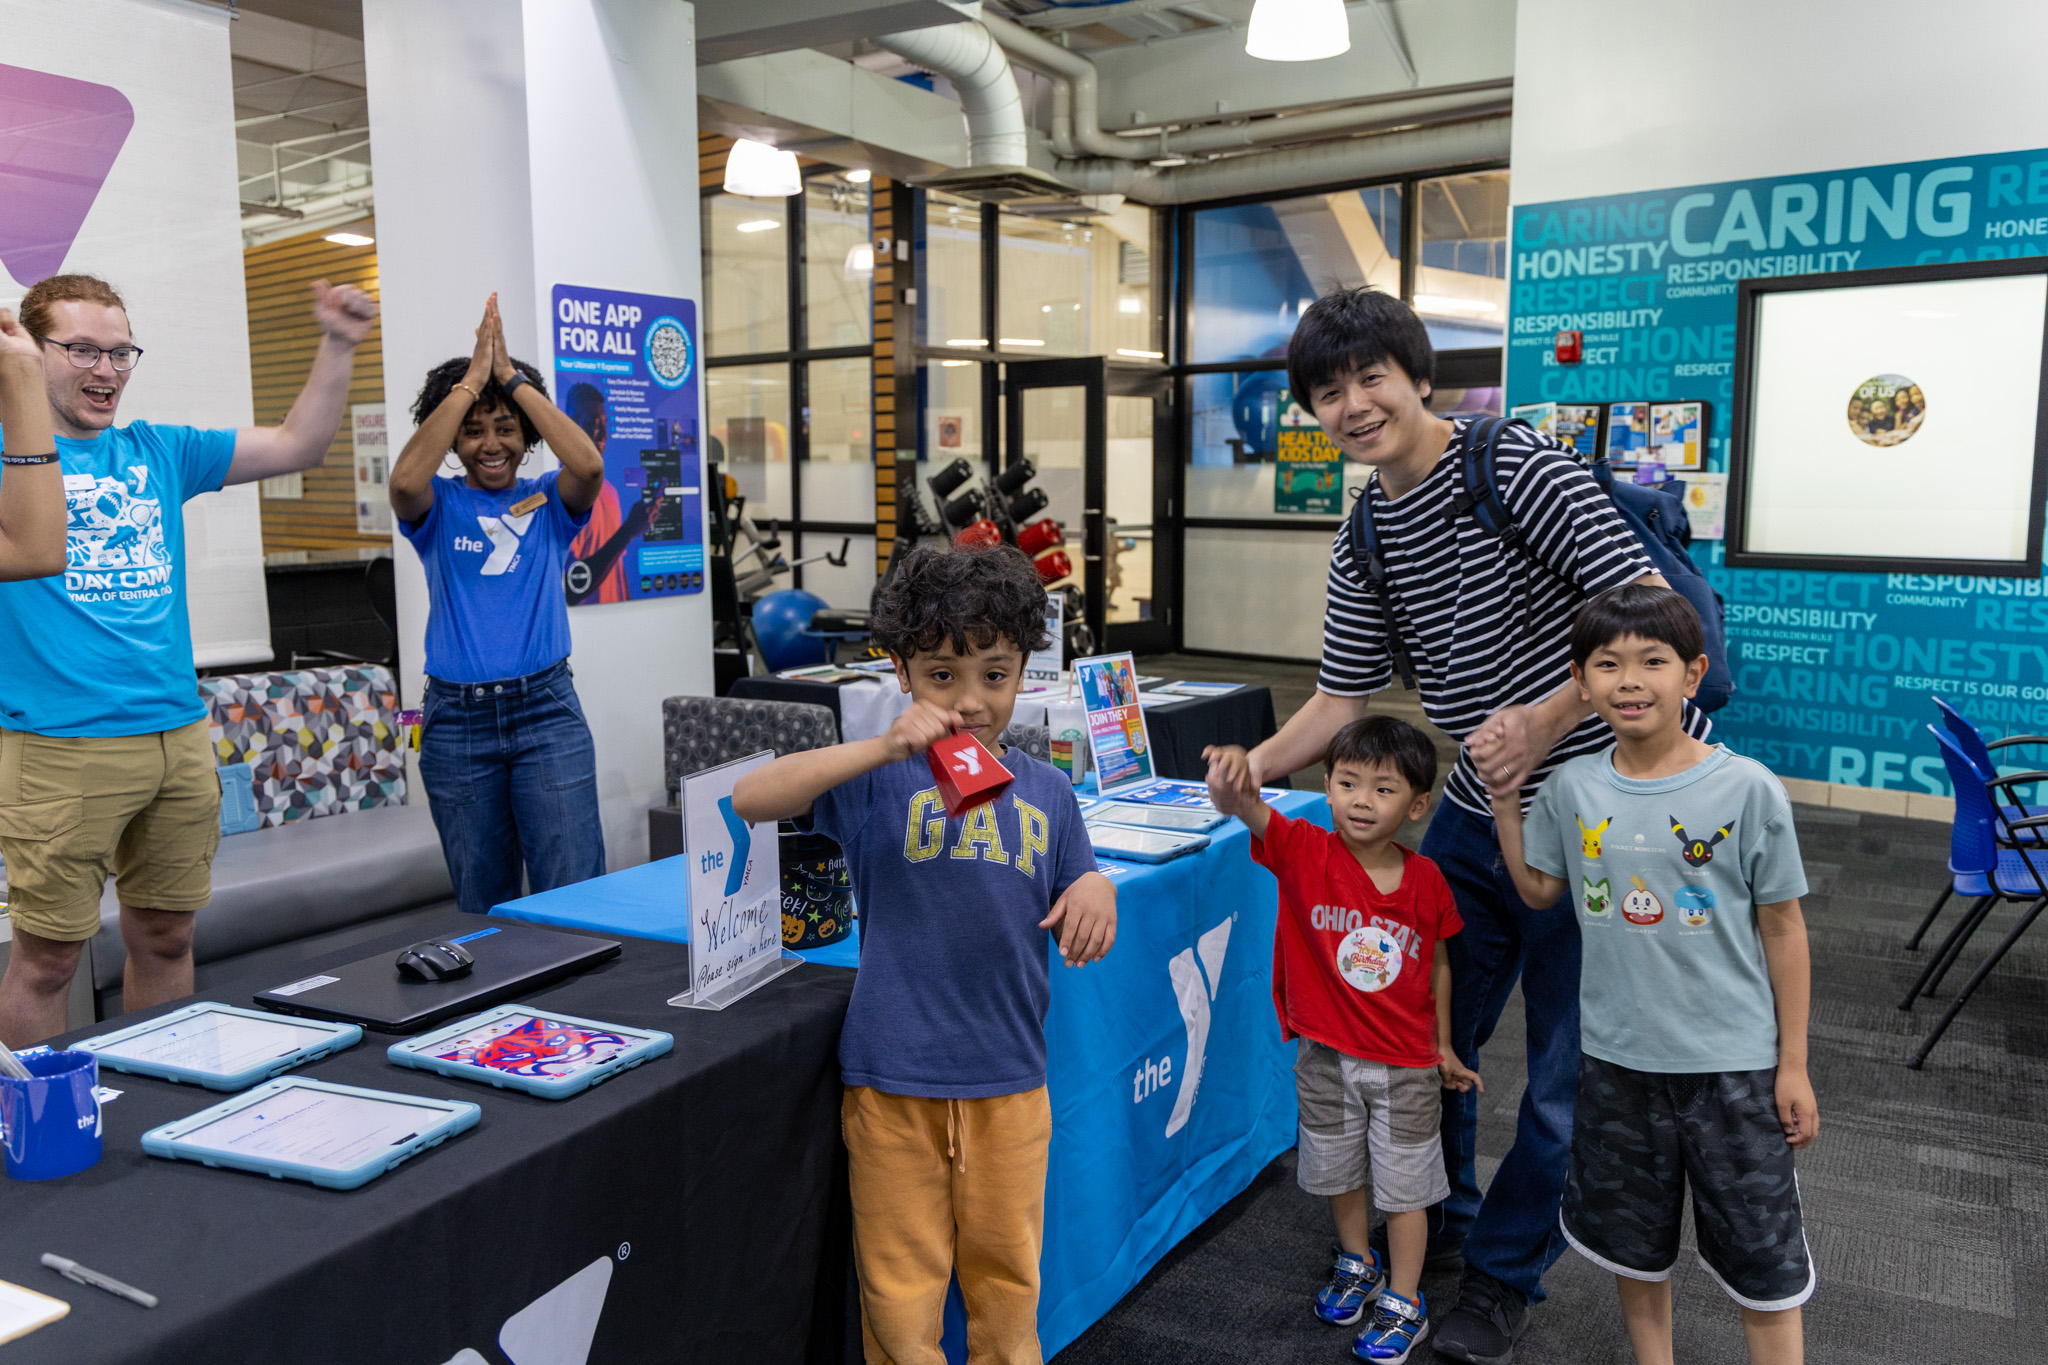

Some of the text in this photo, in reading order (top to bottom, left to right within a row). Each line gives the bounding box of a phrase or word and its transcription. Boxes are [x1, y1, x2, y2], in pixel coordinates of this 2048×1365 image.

[1515, 199, 1666, 248] CARING
[1669, 166, 1974, 258] CARING
[1518, 240, 1669, 280] HONESTY
[1666, 250, 1861, 285] RESPONSIBILITY
[1515, 274, 1664, 313] RESPECT
[1666, 283, 1737, 299] COMMUNITY
[558, 298, 642, 328] ONE APP
[1513, 308, 1663, 333] RESPONSIBILITY
[560, 327, 636, 355] FOR ALL
[1674, 363, 1732, 377] RESPECT
[1540, 367, 1670, 400] CARING
[1859, 385, 1896, 399] OF US
[1277, 431, 1333, 447] HEALTH
[1278, 446, 1341, 462] KIDS DAY
[454, 536, 483, 553] the
[507, 554, 522, 573] YMCA
[64, 572, 113, 590] DAY
[1708, 568, 1880, 608] RESPECT
[67, 592, 101, 602] YMCA
[102, 592, 117, 601] OF
[119, 588, 160, 600] CENTRAL
[1886, 594, 1968, 608] COMMUNITY
[1725, 603, 1878, 631] ESPONSIBILITY
[1741, 642, 1830, 665] RESPECT
[1738, 663, 1888, 709] CARING
[1894, 675, 1961, 694] RESPECT
[1964, 682, 1978, 695] IS
[1981, 683, 2018, 699] OUR
[1090, 712, 1108, 726] JOIN
[1107, 709, 1123, 722] THE
[953, 764, 967, 772] the
[903, 785, 1050, 879] GAP
[701, 850, 724, 874] the
[743, 860, 754, 886] YMCA
[701, 898, 769, 953] Welcome
[1311, 904, 1423, 960] OHIO STATE
[696, 926, 777, 993] Please sign in here
[1351, 952, 1389, 971] Birthday!
[1134, 1056, 1172, 1104] the
[77, 1114, 95, 1129] the
